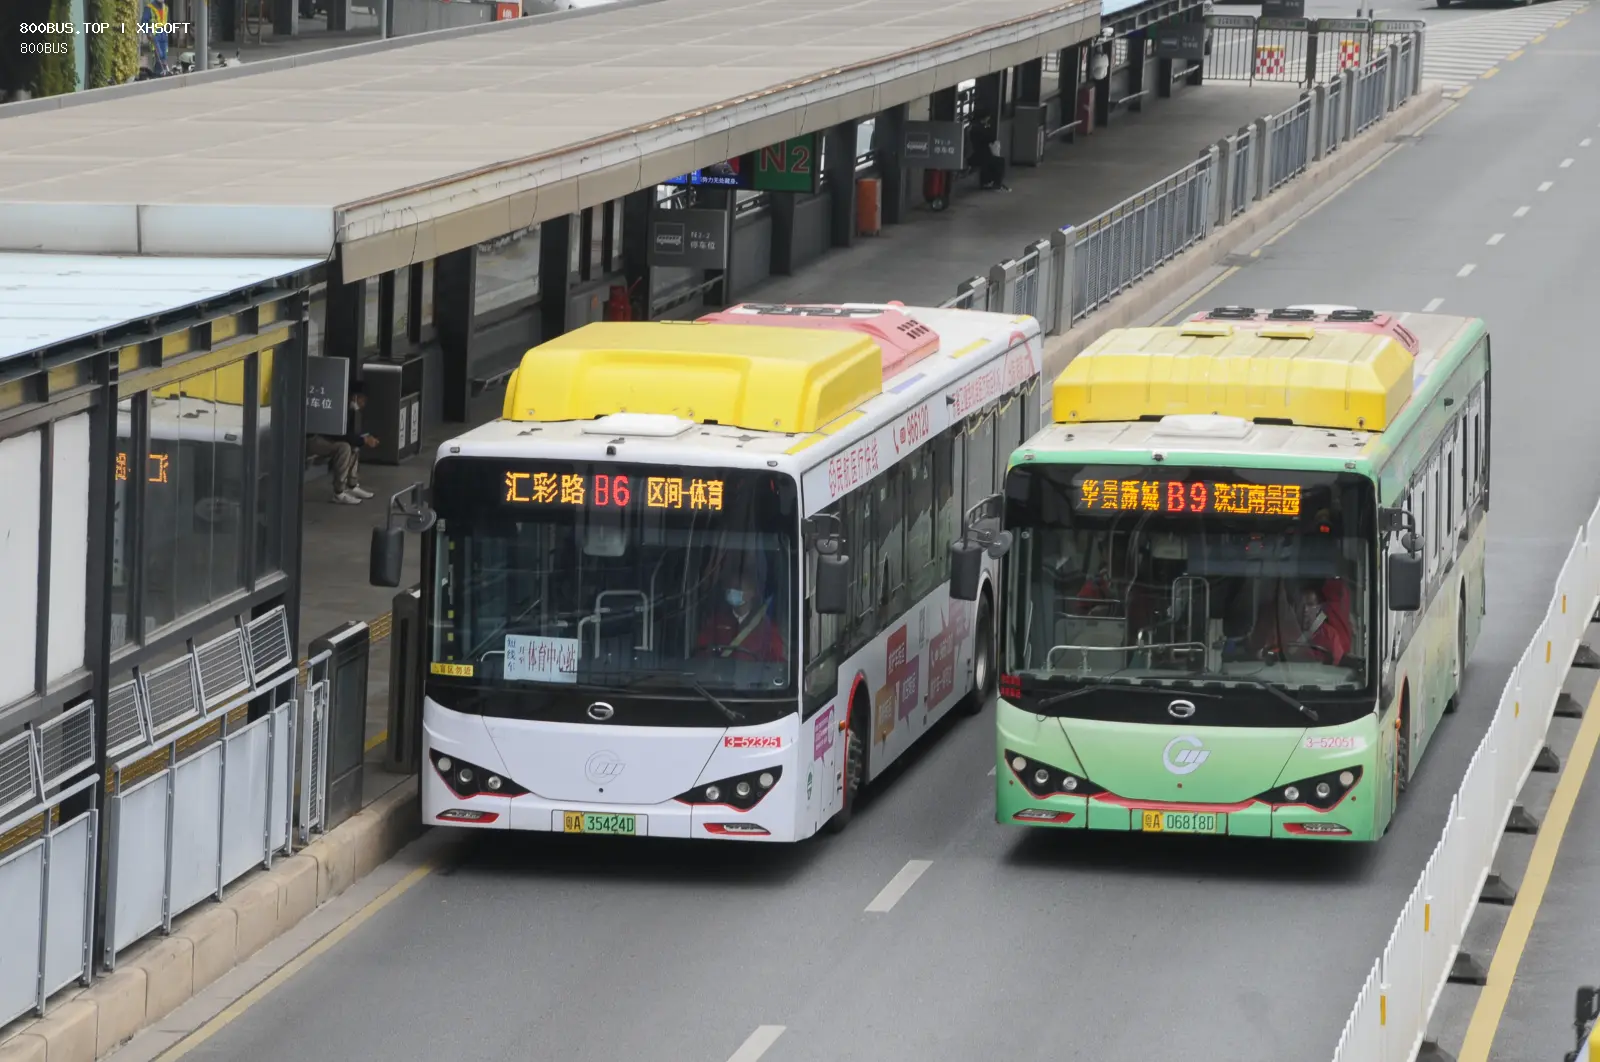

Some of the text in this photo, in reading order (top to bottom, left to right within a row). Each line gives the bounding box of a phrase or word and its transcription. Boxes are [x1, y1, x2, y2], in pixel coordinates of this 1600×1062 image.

[759, 139, 810, 173] N2
[306, 396, 333, 409] 车位
[906, 404, 930, 446] 966120
[505, 471, 586, 505] 汇彩路
[594, 474, 631, 507] B6
[1081, 479, 1160, 511] 华景新城
[1167, 481, 1207, 512] B9
[727, 736, 778, 748] 3-52325
[1306, 737, 1355, 749] 3-52051
[587, 815, 635, 833] 35424D
